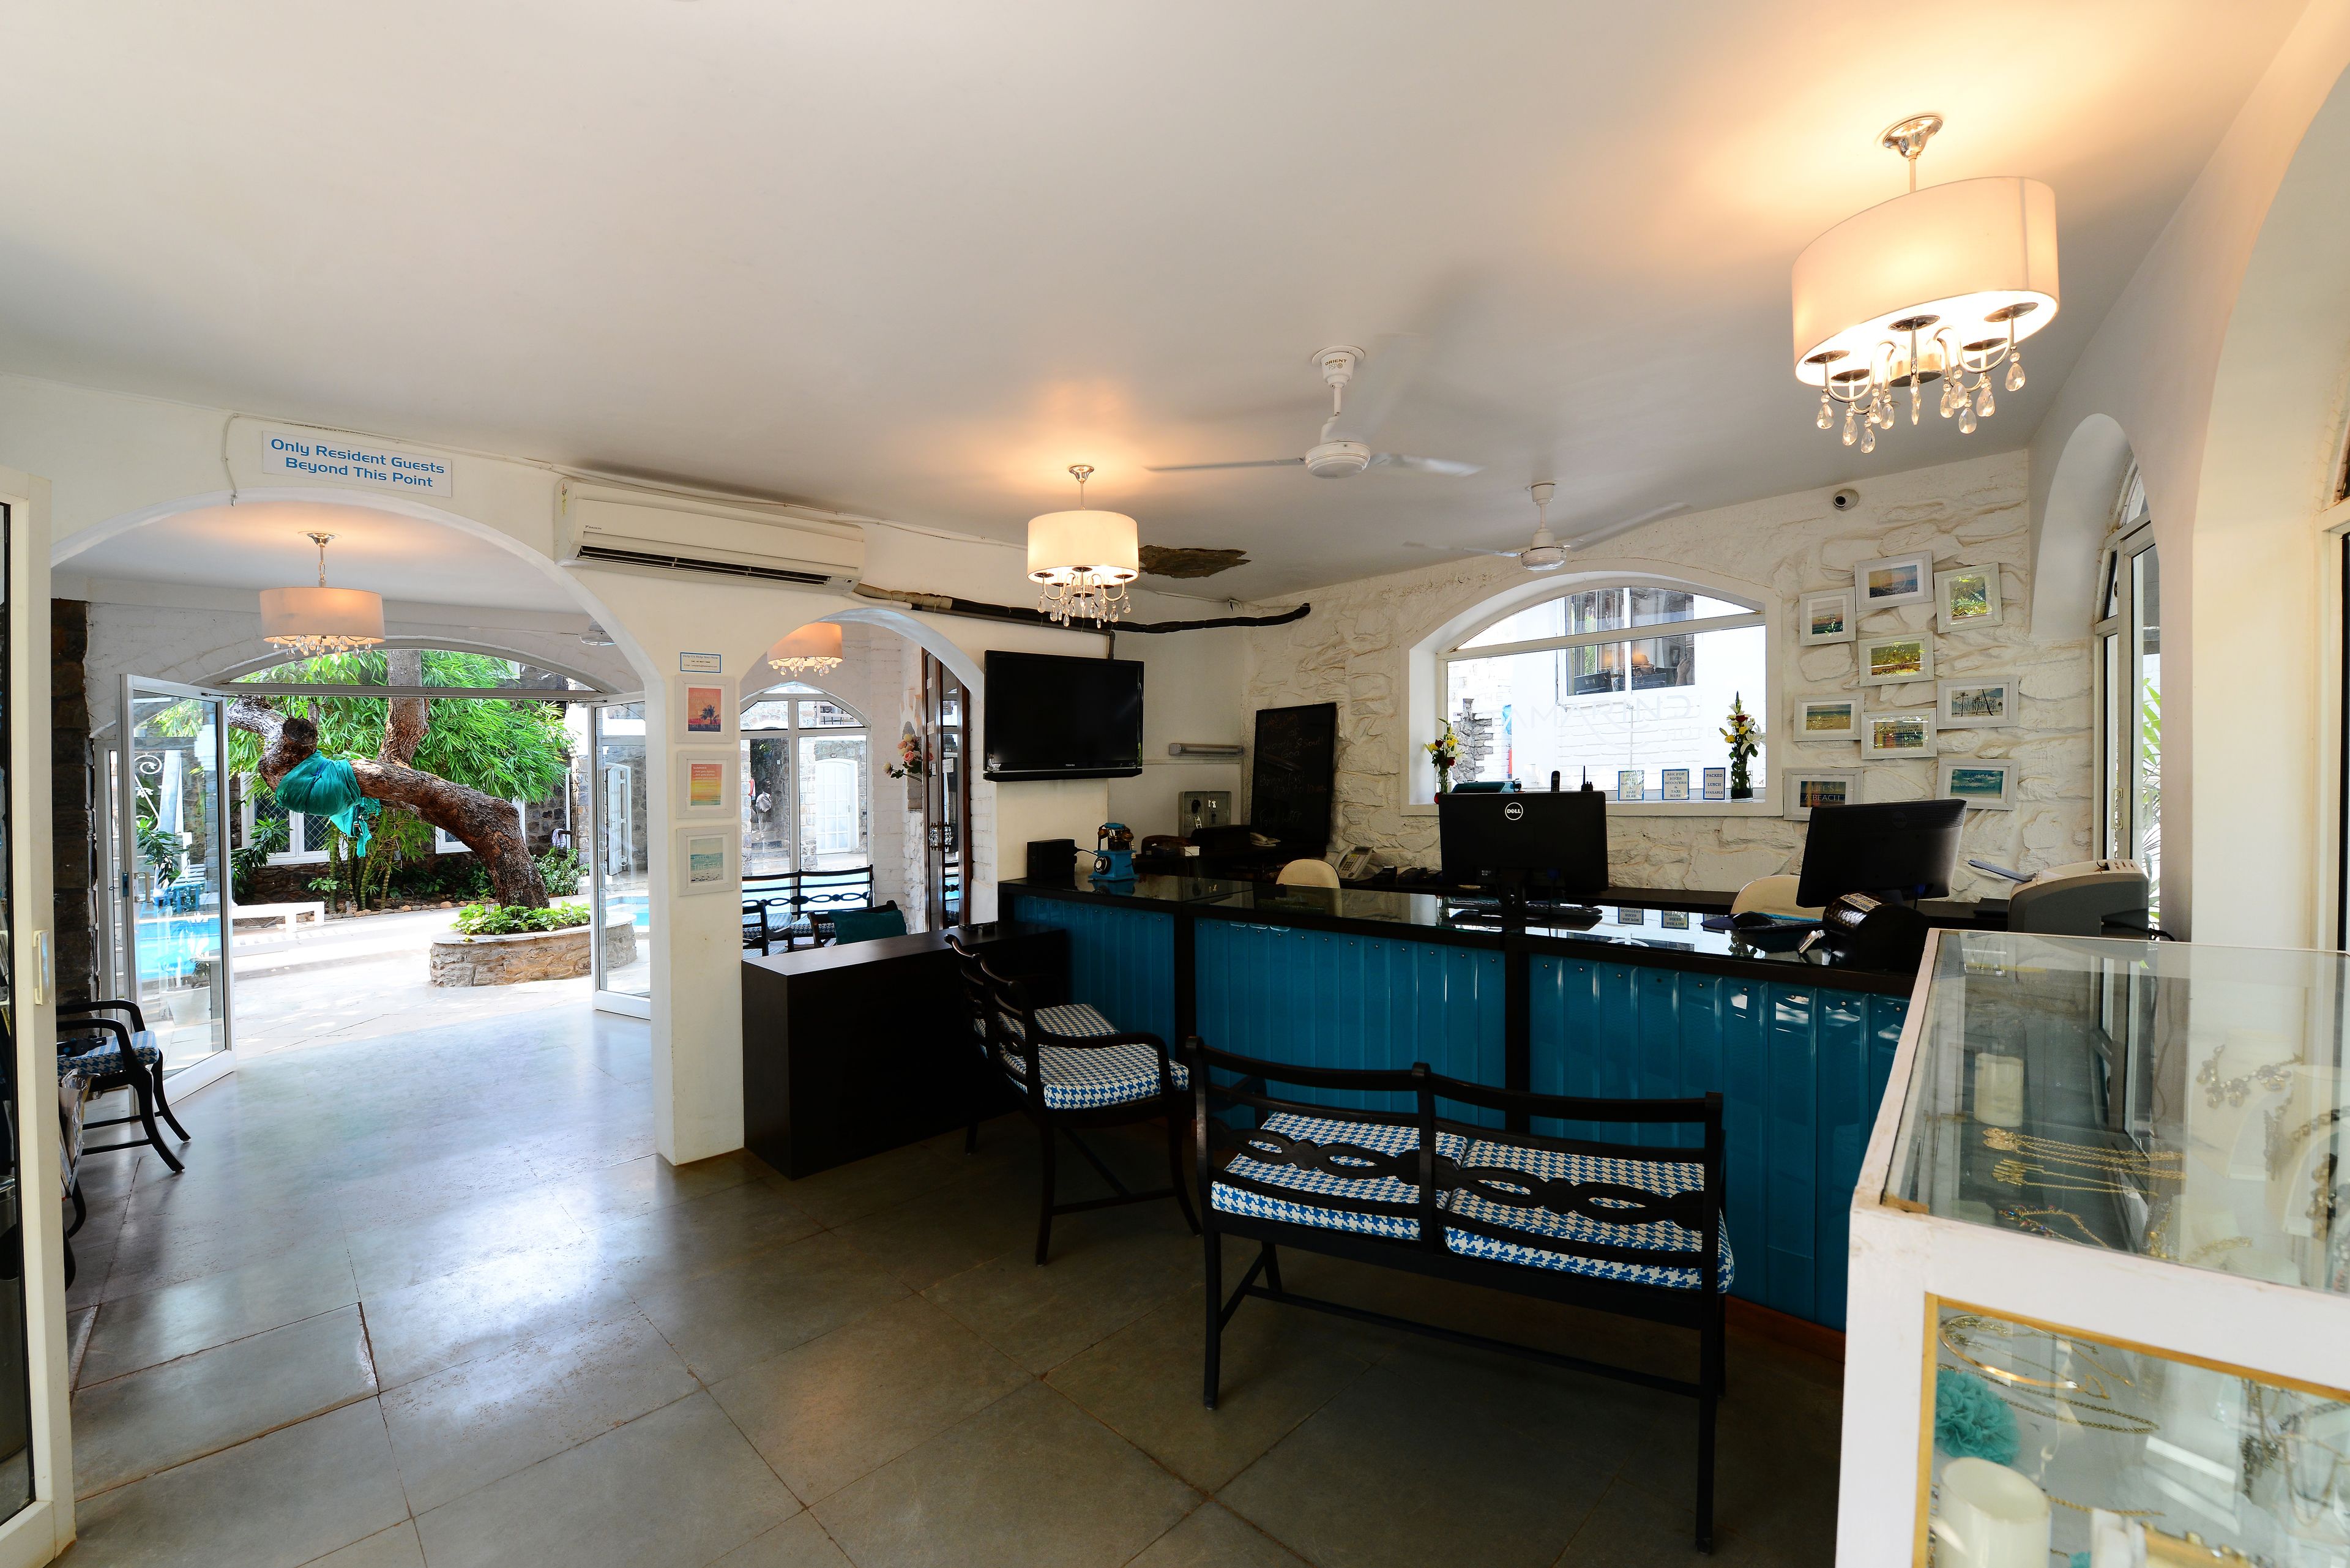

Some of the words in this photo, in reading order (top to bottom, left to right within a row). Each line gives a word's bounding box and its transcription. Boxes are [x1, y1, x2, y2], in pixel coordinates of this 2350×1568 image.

[271, 438, 309, 457] Only
[316, 445, 386, 466] Resident
[391, 457, 444, 474] Guests
[286, 457, 348, 476] Beyond
[353, 466, 387, 481] This
[393, 472, 433, 488] Point
[1484, 695, 1691, 749] TAMARIND
[1281, 749, 1300, 759] Goa
